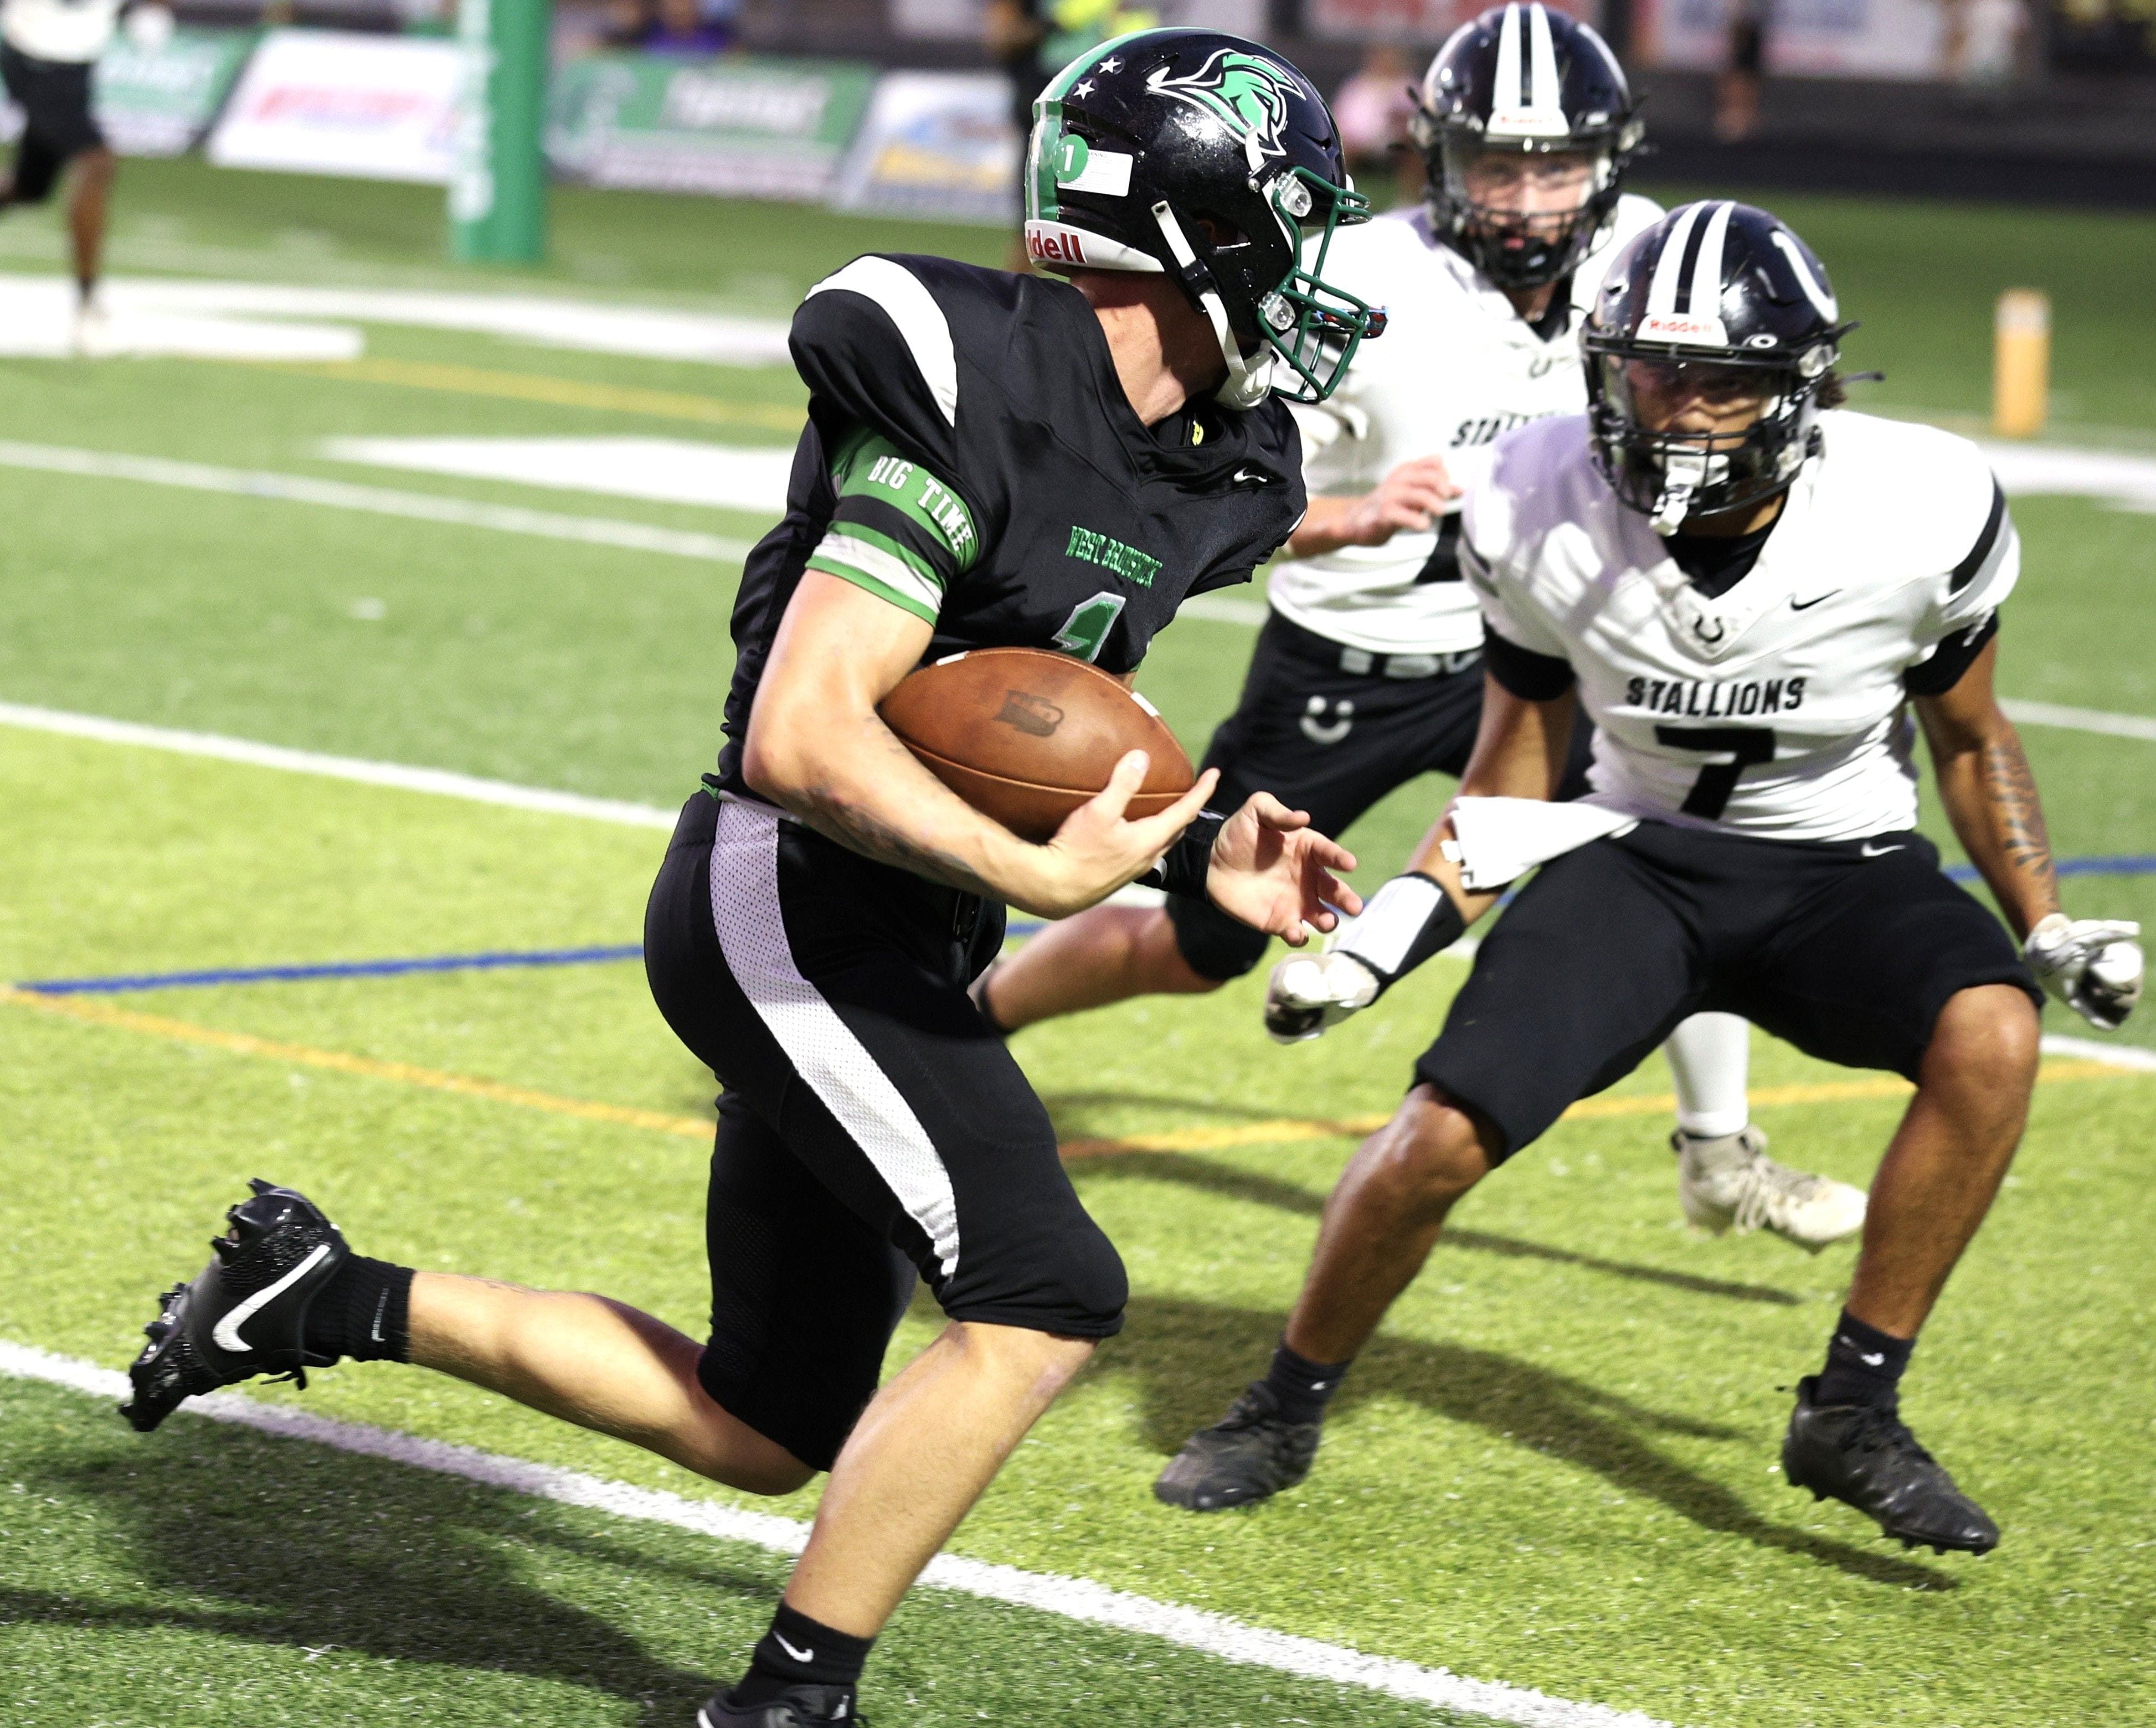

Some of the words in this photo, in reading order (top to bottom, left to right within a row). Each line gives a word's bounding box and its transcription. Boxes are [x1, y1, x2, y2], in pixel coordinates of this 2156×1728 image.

[1064, 145, 1074, 172] 1
[867, 455, 914, 490] BIG
[918, 477, 973, 551] TIME
[1065, 525, 1107, 564] WEST
[1626, 677, 1807, 716] STALLIONS
[1653, 725, 1776, 821] 7
